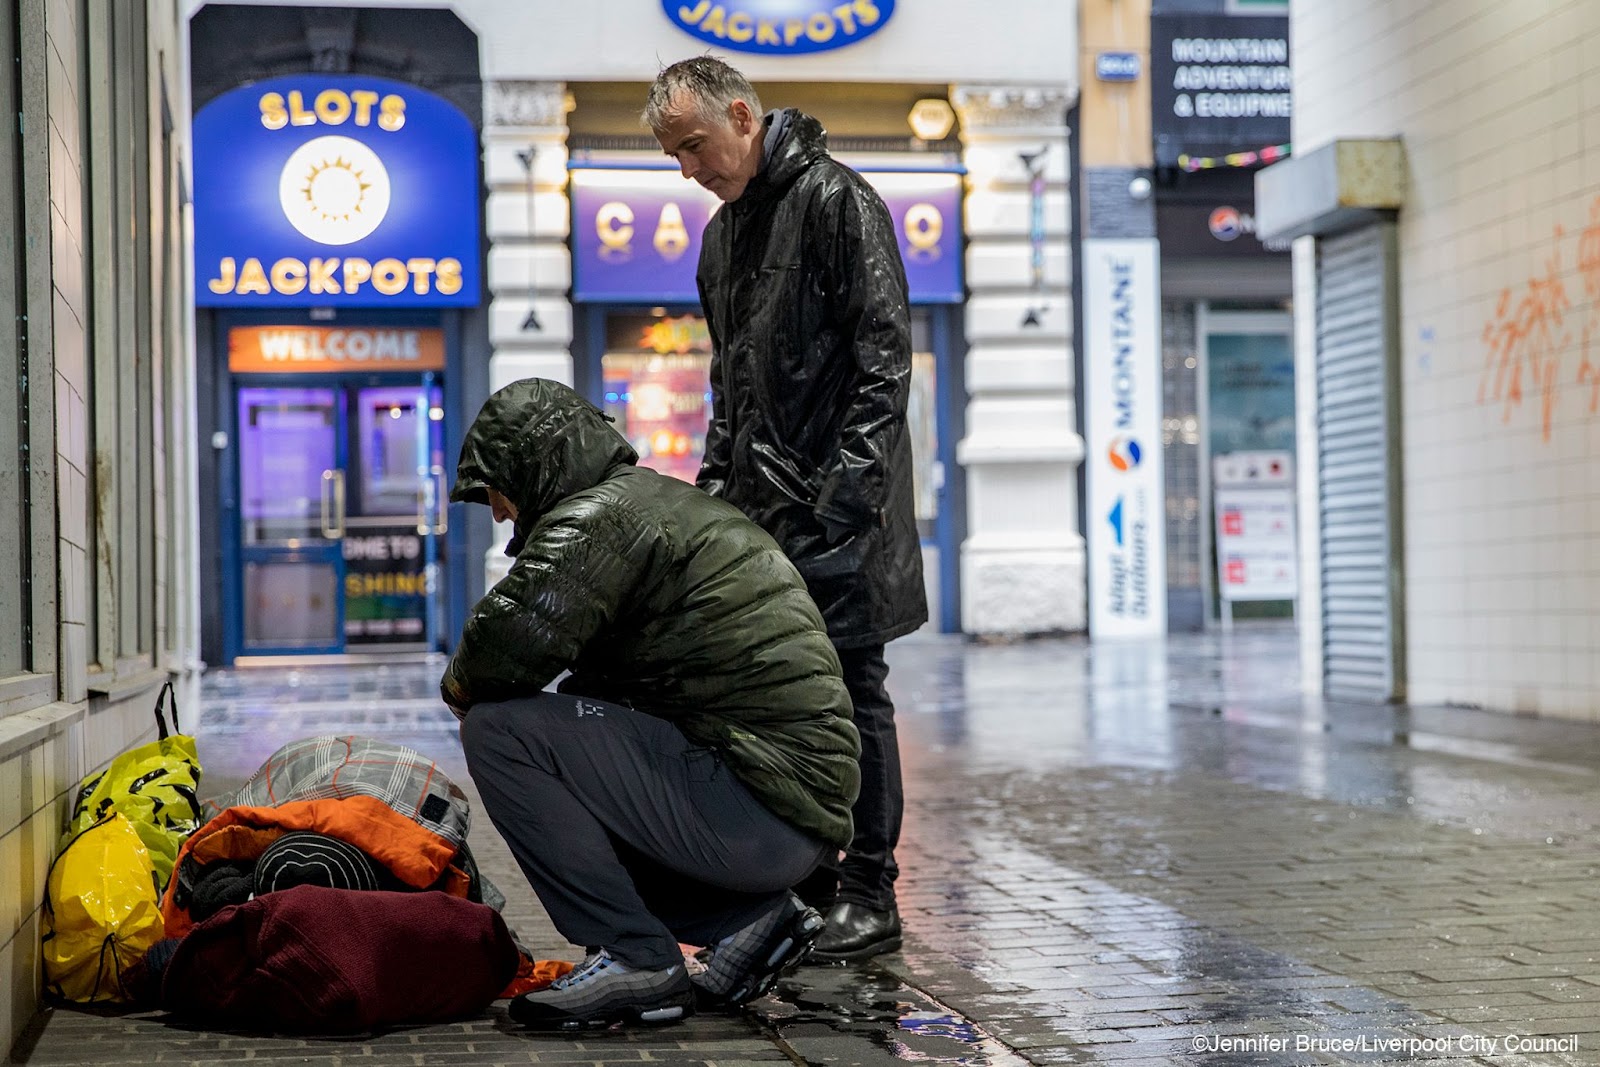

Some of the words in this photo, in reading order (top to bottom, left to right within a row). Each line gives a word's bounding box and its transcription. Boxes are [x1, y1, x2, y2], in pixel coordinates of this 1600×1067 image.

[678, 0, 880, 46] JACKPOTS
[1172, 38, 1287, 62] MOUNTAIN
[1173, 65, 1290, 90] ADVENTUR
[259, 89, 406, 131] SLOTS
[1173, 93, 1194, 117] &
[1195, 92, 1291, 117] EQUIPME
[208, 257, 463, 295] JACKPOTS
[258, 330, 419, 361] WELCOME
[1111, 257, 1136, 429] MONTANE
